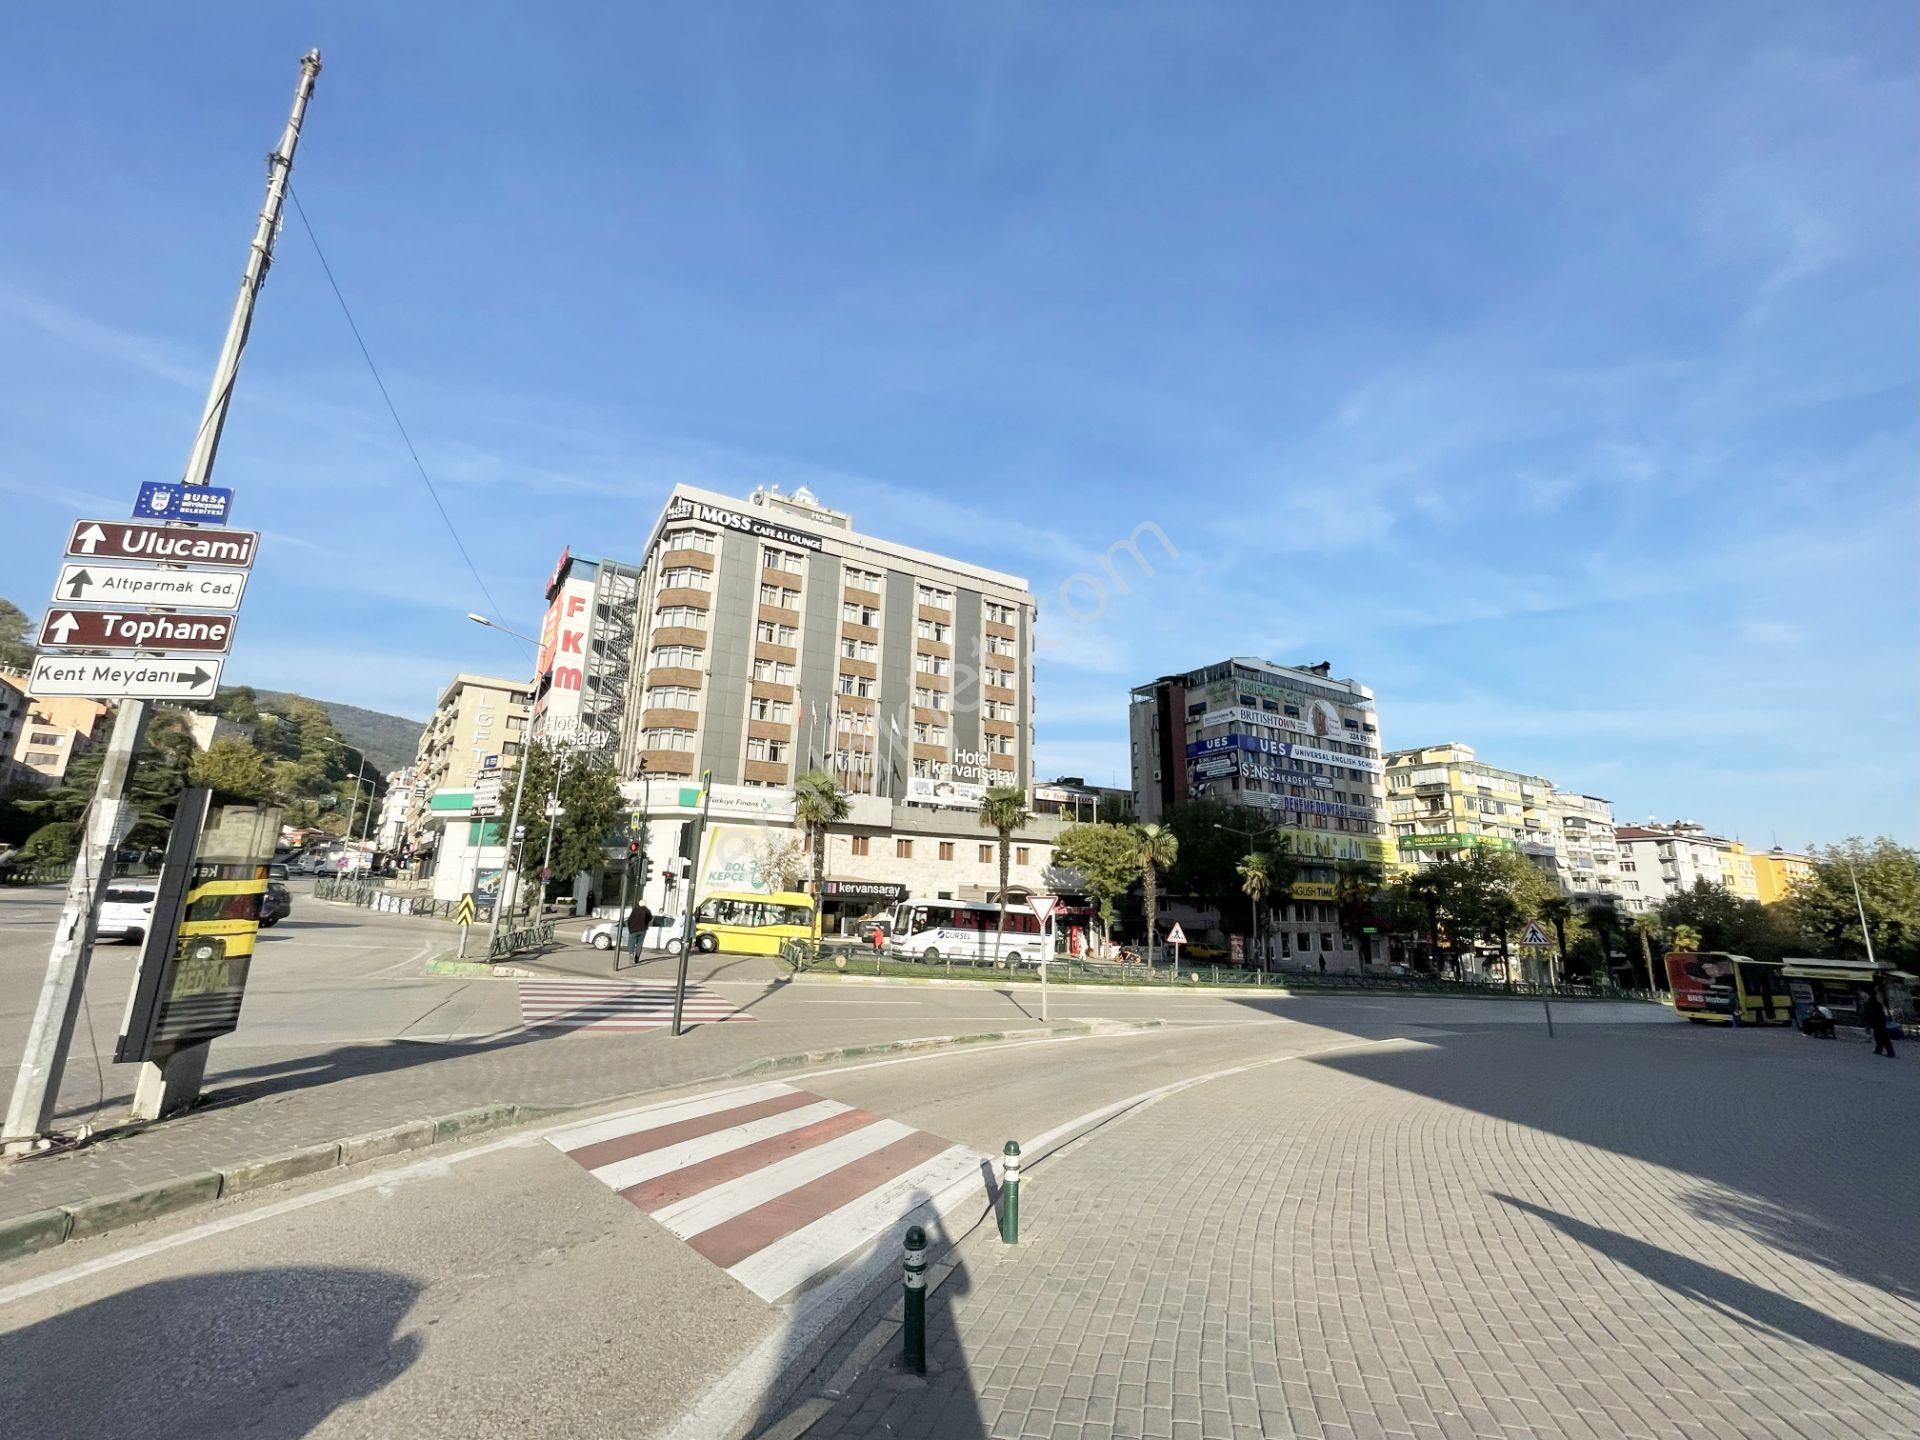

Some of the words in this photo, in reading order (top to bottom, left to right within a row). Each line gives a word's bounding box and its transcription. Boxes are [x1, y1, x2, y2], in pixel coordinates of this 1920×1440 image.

[183, 492, 227, 504] BURSA
[700, 504, 752, 532] MOSS
[753, 525, 776, 538] CAFE
[783, 532, 822, 550] LOUNGE
[122, 529, 250, 560] Ulucami
[102, 577, 194, 594] Altıparmak
[200, 581, 235, 596] Cad.
[102, 614, 226, 646] Tophane
[37, 665, 86, 682] Kent
[92, 666, 175, 687] Meydanı
[1239, 708, 1297, 730] BRITISHTOWN
[1206, 736, 1228, 749] UES
[1259, 738, 1287, 756] UES
[1294, 748, 1330, 761] UNIVERSAL
[1331, 754, 1357, 767] ENGLISH
[955, 747, 990, 767] Hotel
[931, 758, 1018, 785] kervansaray
[1242, 763, 1275, 782] SENSE
[736, 798, 760, 807] Finans
[839, 882, 901, 897] kervansaray
